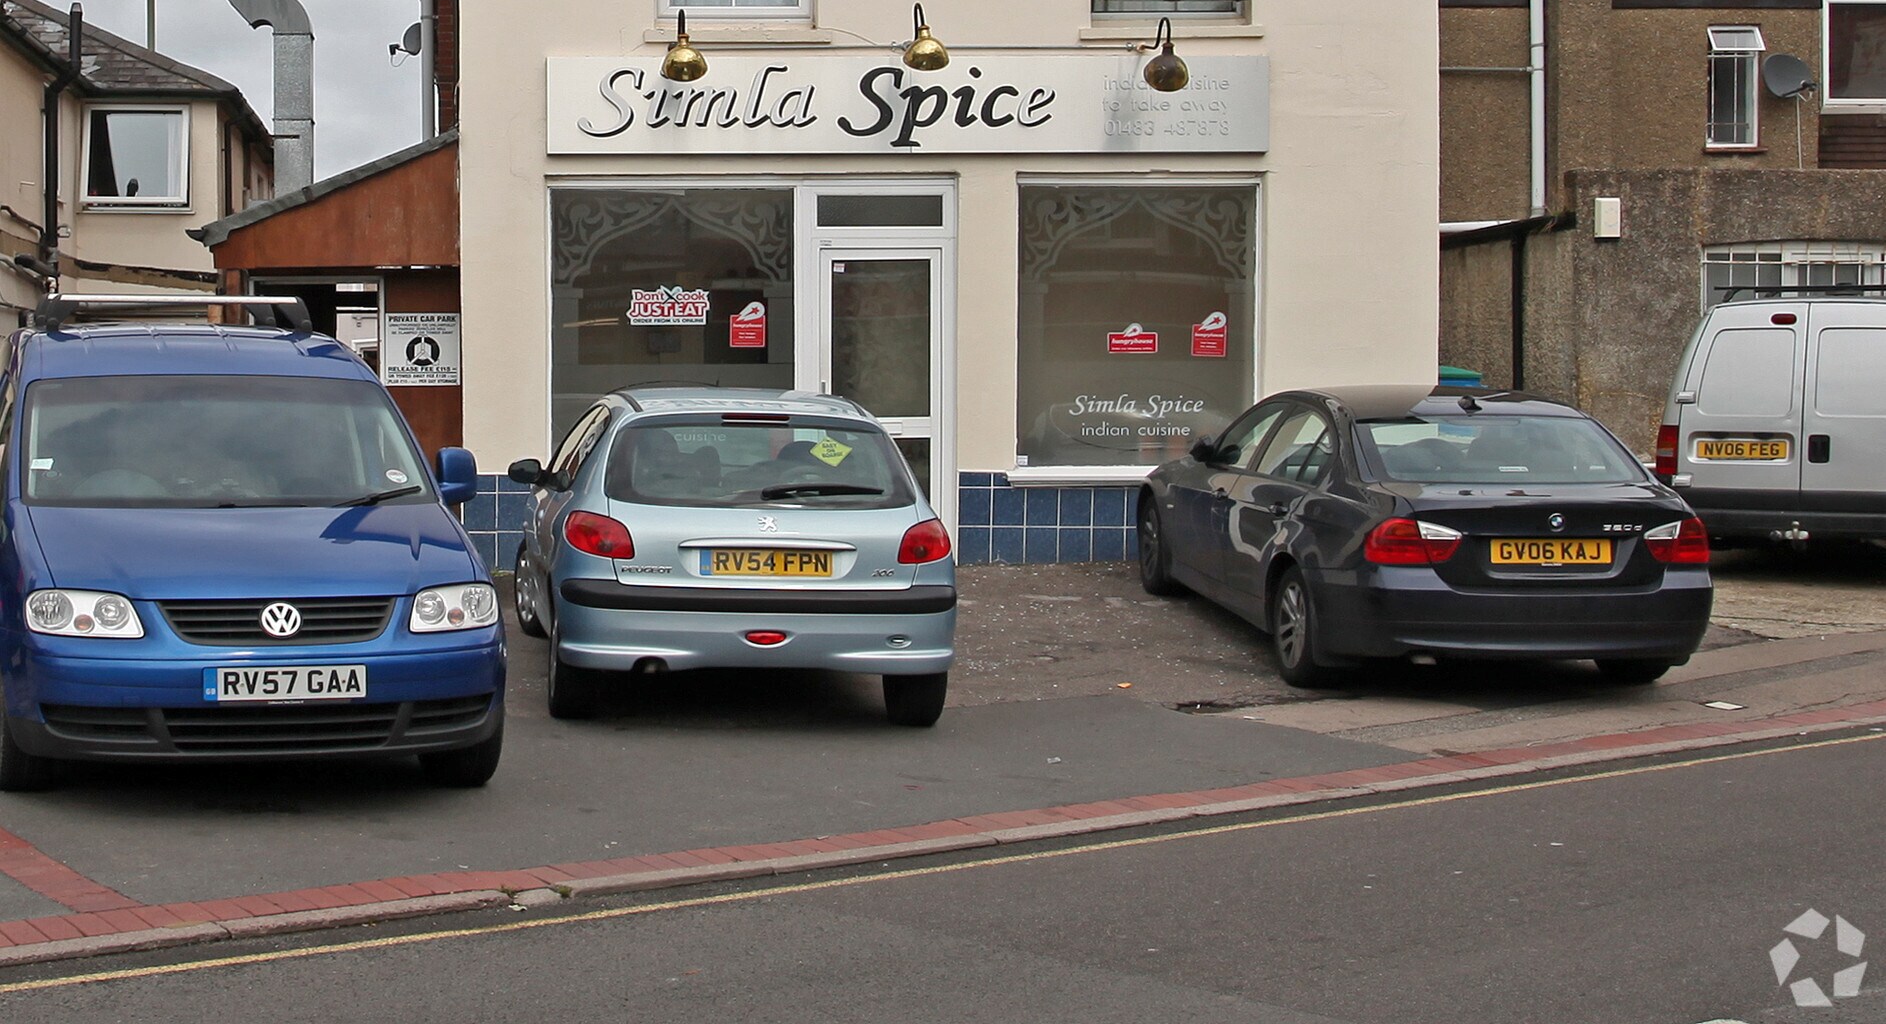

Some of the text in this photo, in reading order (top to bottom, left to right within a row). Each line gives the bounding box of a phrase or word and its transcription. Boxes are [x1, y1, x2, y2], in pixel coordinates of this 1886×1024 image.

[1103, 74, 1153, 91] india
[577, 64, 1056, 148] Simla Spice
[1102, 96, 1228, 115] to take away
[1103, 120, 1230, 136] 01483 487878
[634, 290, 705, 301] Don't cook
[630, 302, 707, 316] JUST EAT
[1069, 394, 1204, 418] Simla Spice
[674, 430, 727, 442] cuisine
[1081, 422, 1191, 436] indian cuisine
[1704, 443, 1780, 455] NV06 FEG
[1500, 542, 1601, 560] GV06 KAJ
[621, 565, 673, 574] PEUGEOT
[714, 552, 828, 573] RV54 FPN
[223, 669, 361, 695] RV57 GAA
